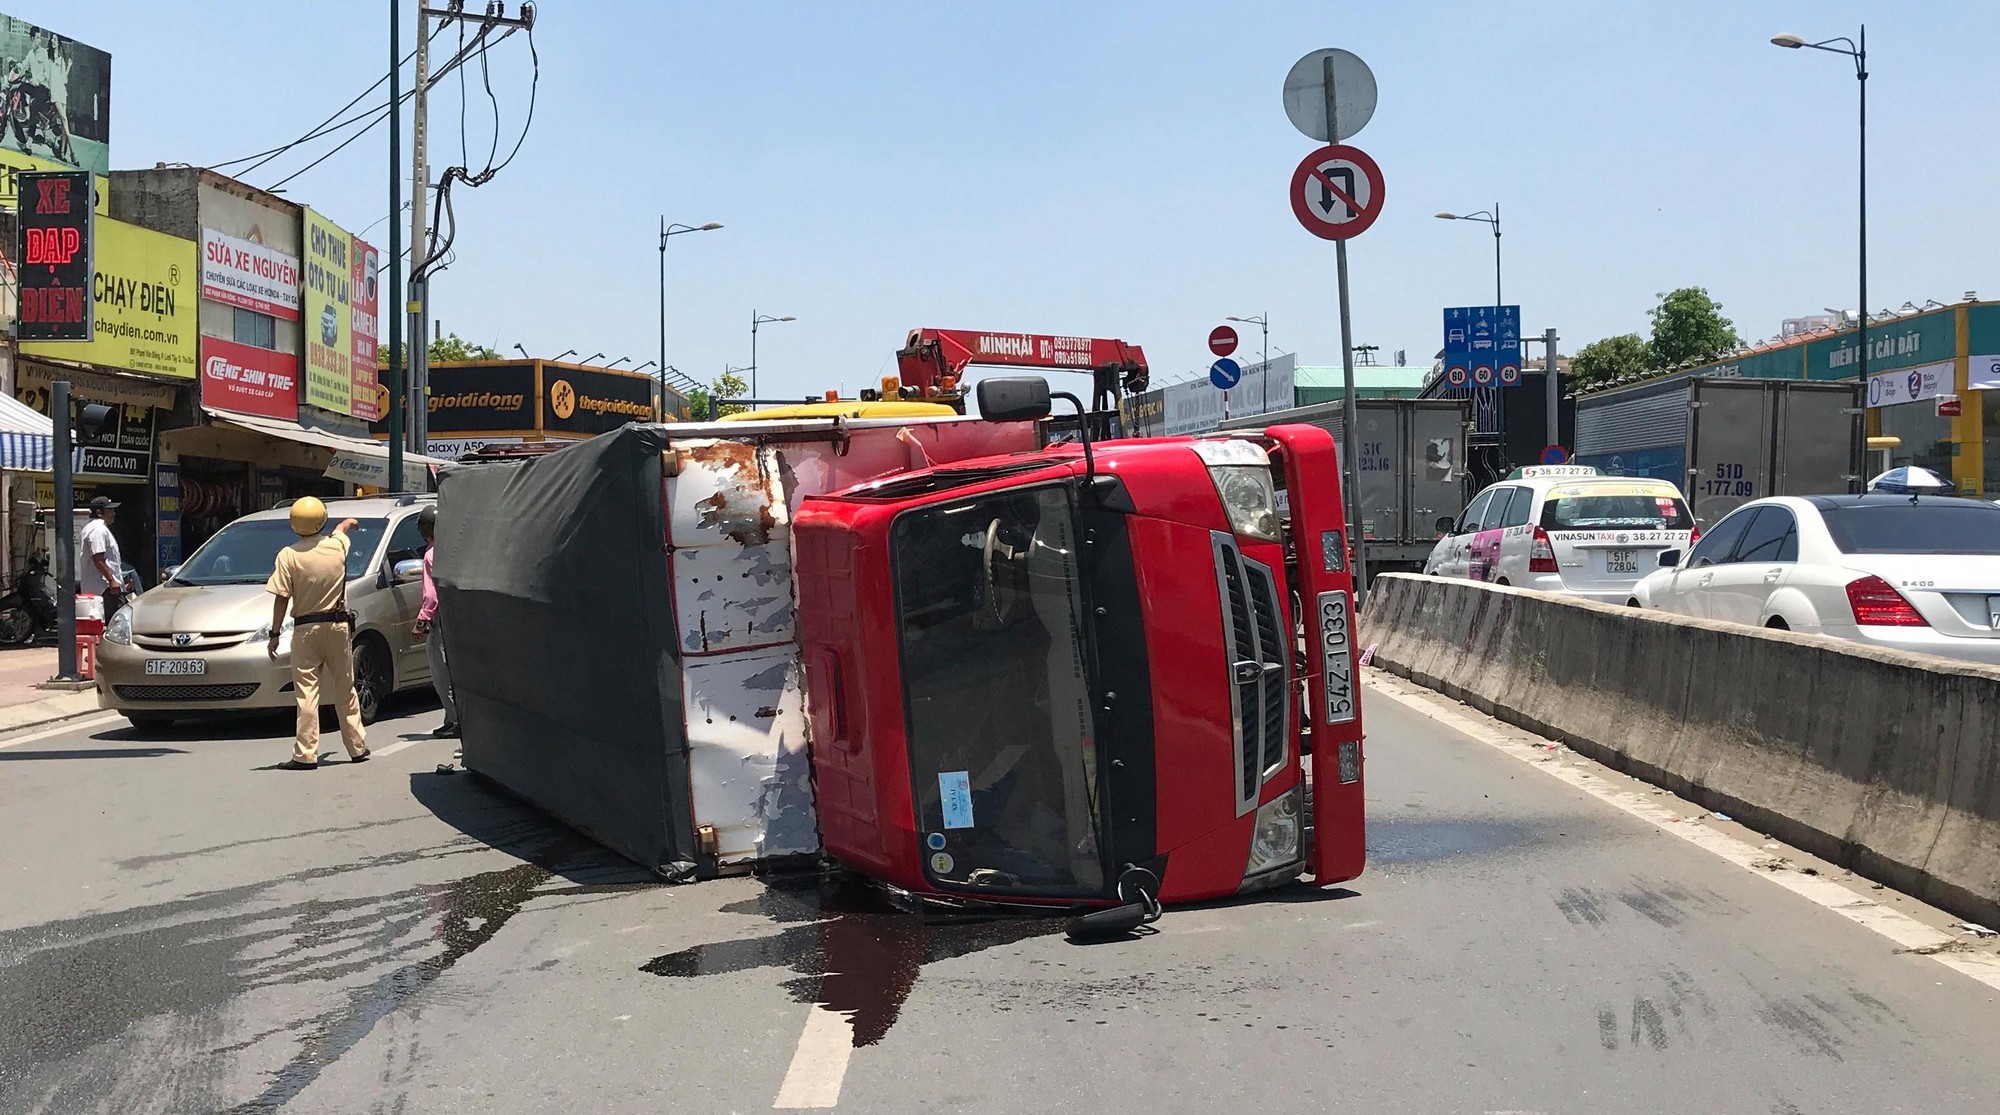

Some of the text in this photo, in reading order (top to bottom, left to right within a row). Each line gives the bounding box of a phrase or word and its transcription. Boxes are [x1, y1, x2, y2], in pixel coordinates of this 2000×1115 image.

[37, 179, 71, 214] XE
[26, 227, 80, 274] ĐẠP
[311, 222, 346, 270] CHO THUÊ
[207, 237, 297, 287] SỬA XE NGUYÊN
[21, 277, 83, 332] ĐIỆN
[93, 271, 138, 315] CHẠY
[140, 281, 175, 322] ĐIỆN
[257, 286, 264, 295] XE
[264, 289, 280, 299] HONDA
[282, 293, 291, 302] TAY
[291, 295, 298, 304] GA
[352, 306, 377, 339] CAMERA
[1876, 334, 1895, 359] CÀI
[1898, 331, 1921, 358] ĐẶT
[206, 355, 242, 380] CHENG
[239, 368, 266, 386] SHIN
[267, 373, 294, 391] TIRE
[1452, 371, 1463, 381] 60
[1479, 370, 1488, 380] 60
[1504, 369, 1514, 379] 60
[1910, 373, 1919, 390] 2
[399, 391, 524, 414] tgioididong
[578, 395, 652, 420] thegioididong
[120, 434, 150, 447] TOÀN QUỐC
[1363, 442, 1383, 456] 51C
[158, 471, 179, 488] HONDA
[1716, 463, 1743, 479] 51D
[1554, 532, 1596, 541] VINASUN
[1596, 532, 1615, 540] TAXI
[1664, 532, 1675, 540] 27
[1678, 532, 1689, 541] 27
[1613, 552, 1630, 561] 51F
